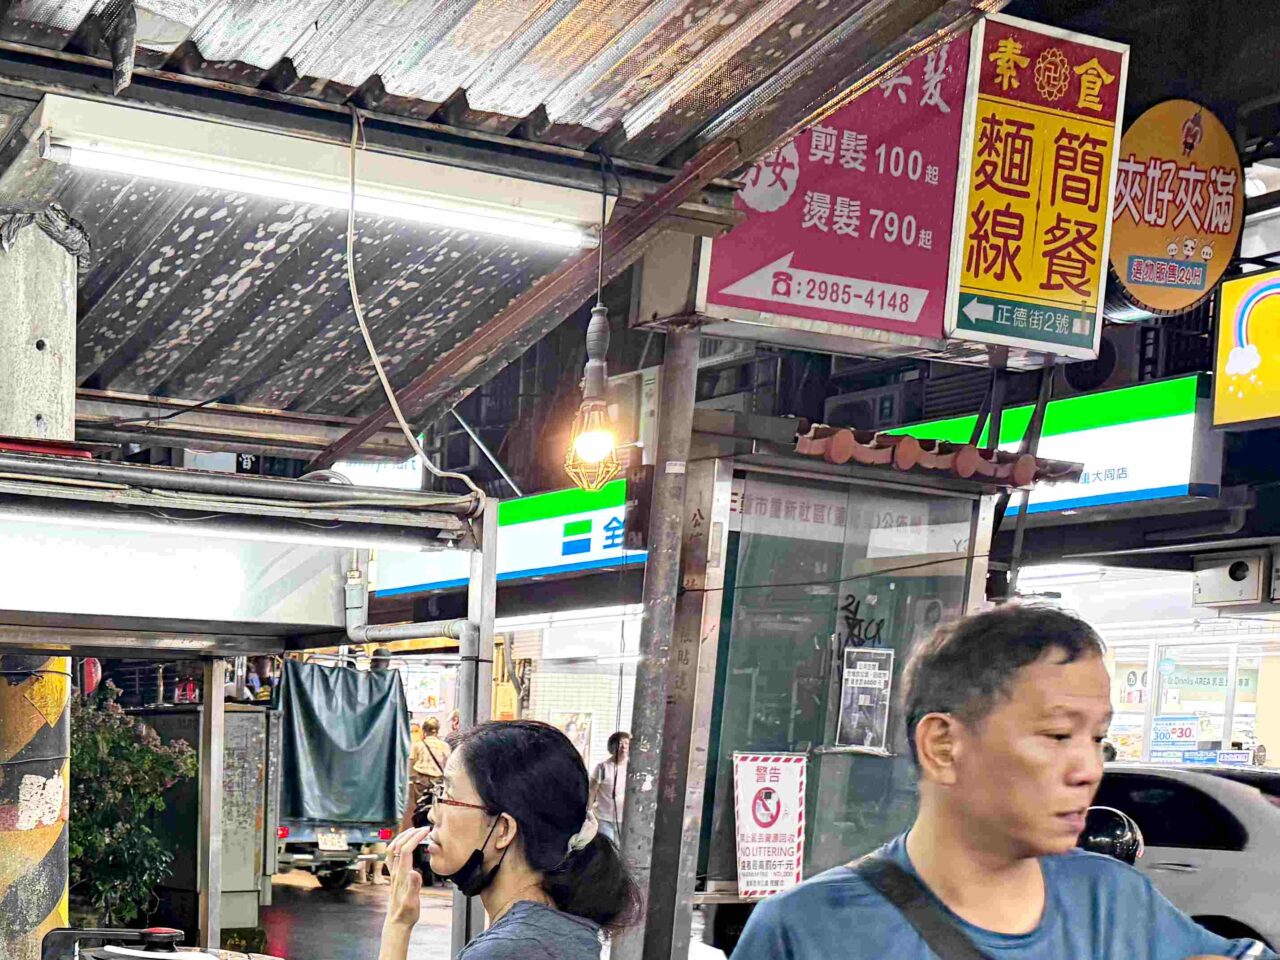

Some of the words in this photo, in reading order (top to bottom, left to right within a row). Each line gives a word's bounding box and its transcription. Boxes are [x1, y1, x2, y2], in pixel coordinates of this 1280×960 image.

[966, 112, 1036, 282] 麵線
[1039, 126, 1108, 298] 簡餐
[1113, 153, 1238, 235] 夾好夾滿
[995, 303, 1070, 335] 正德街2號
[755, 765, 781, 783] 警告
[740, 846, 751, 857] NO
[752, 846, 795, 857] LITTERING
